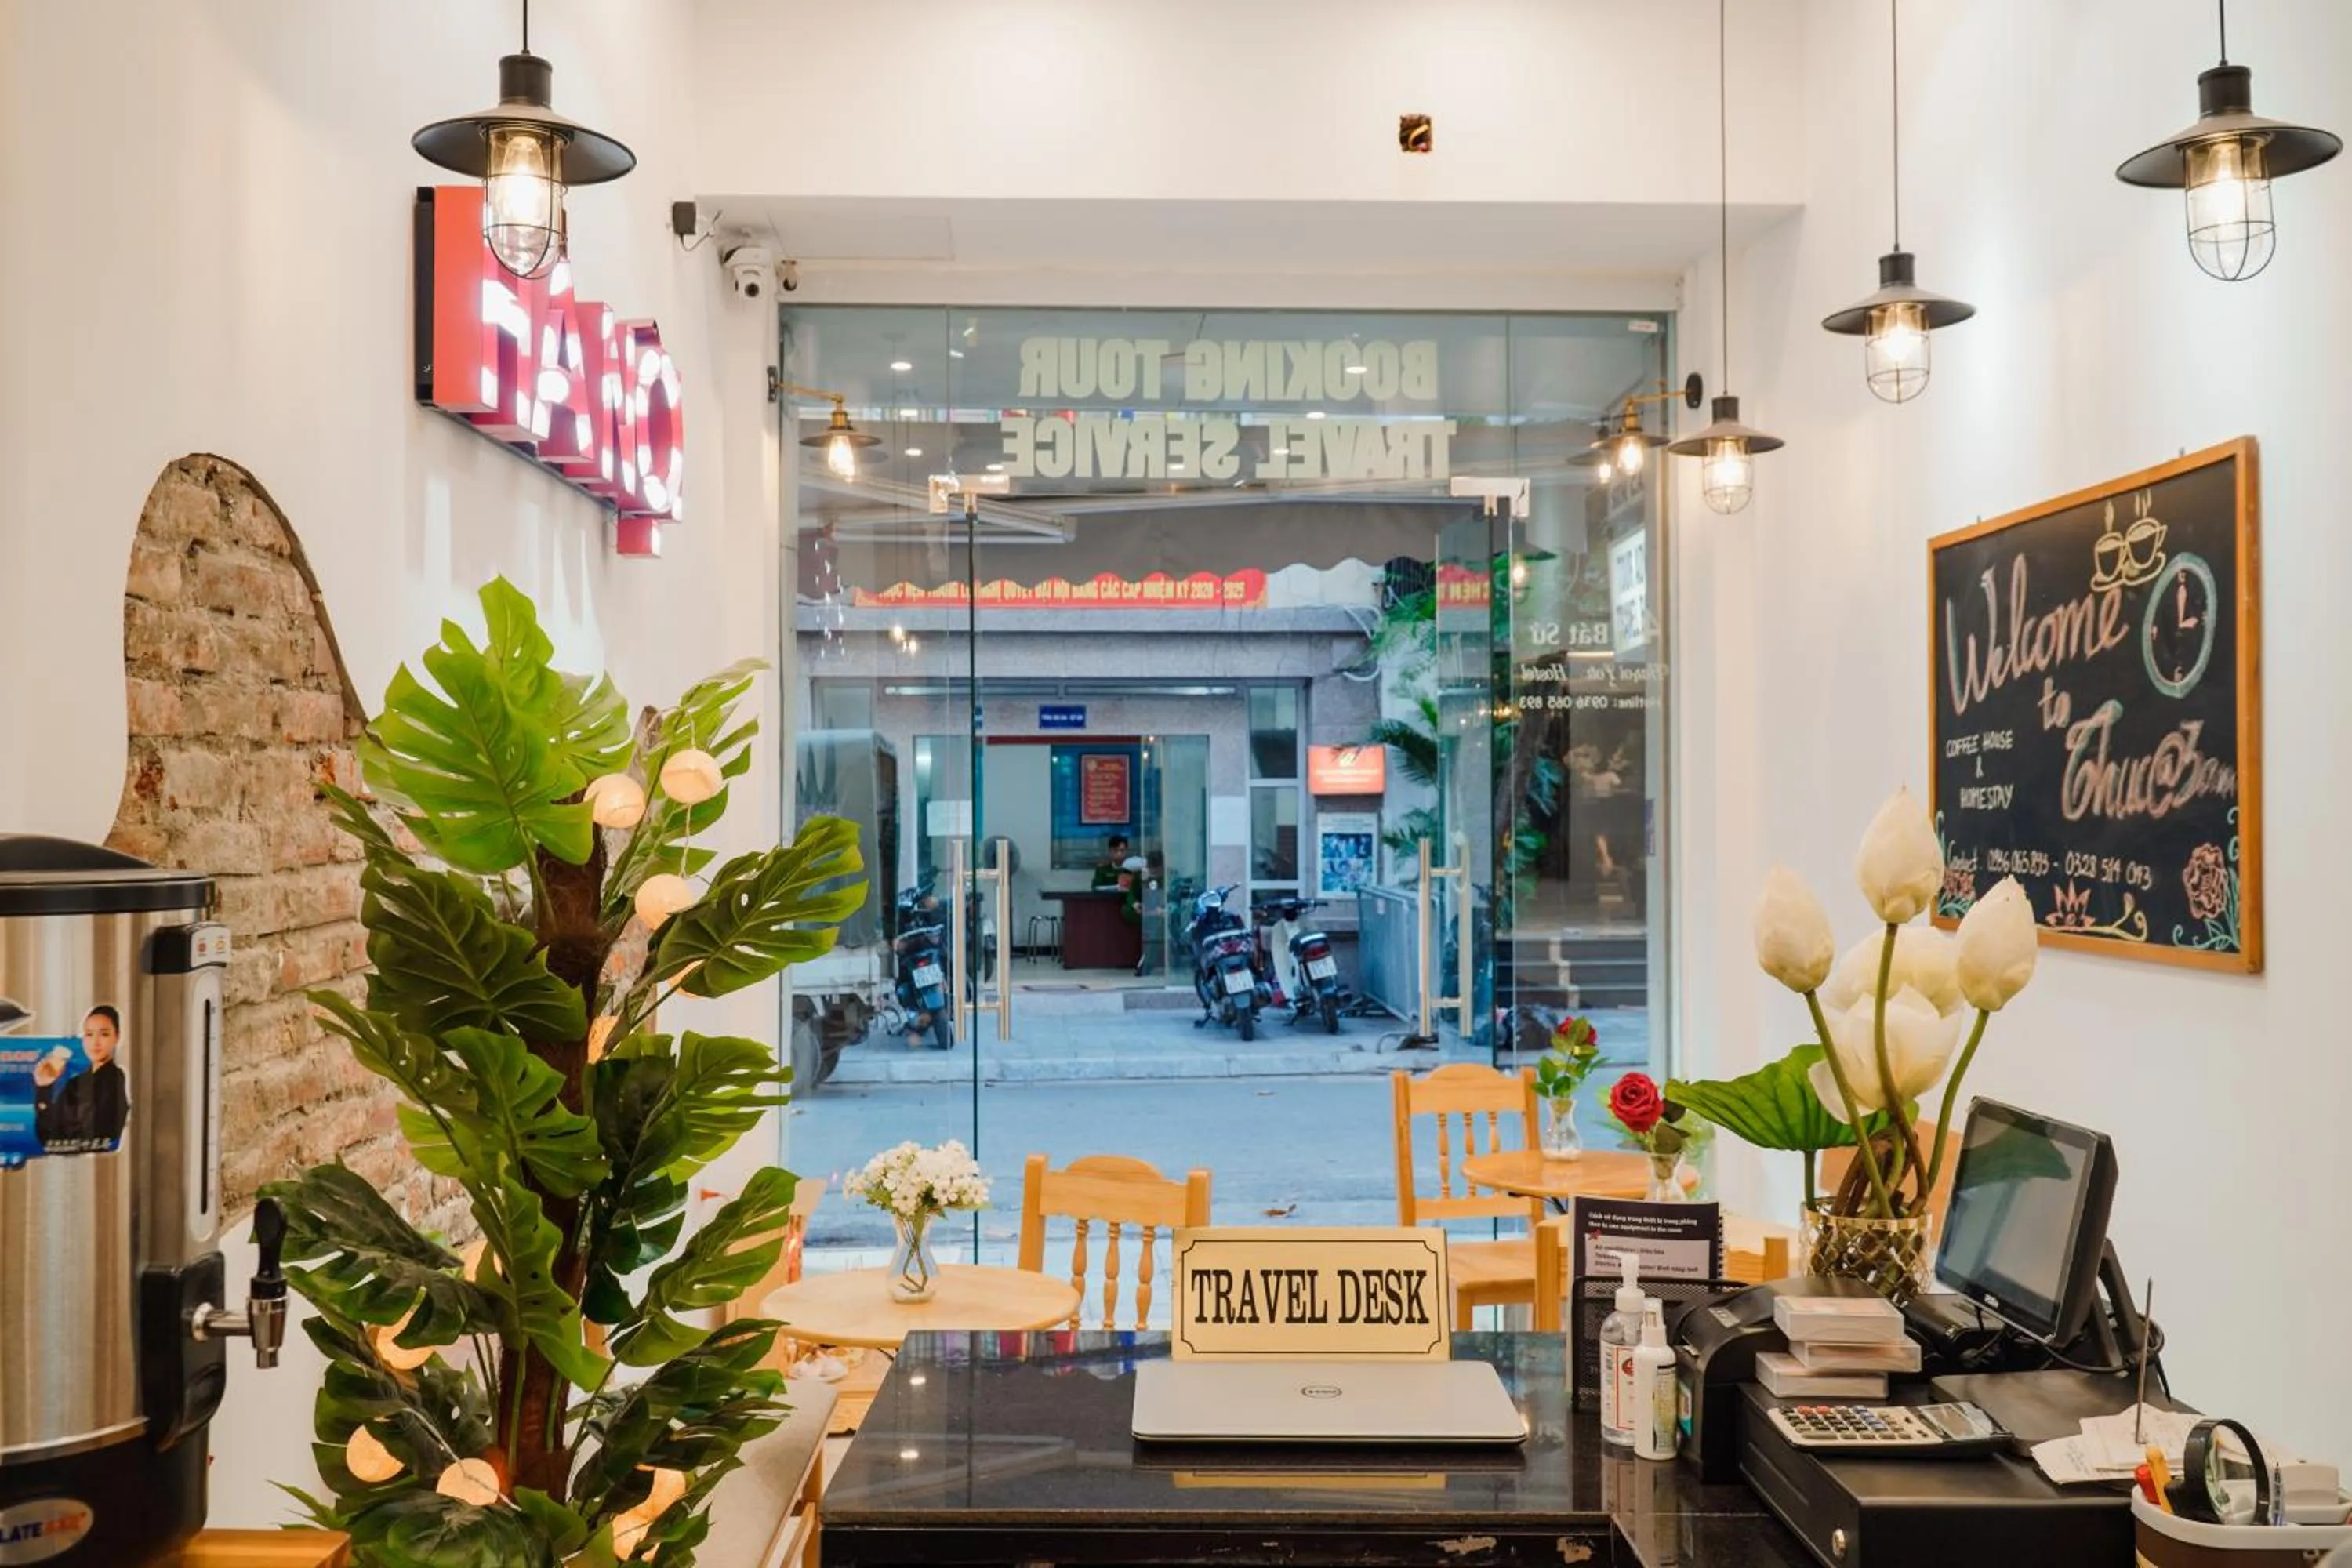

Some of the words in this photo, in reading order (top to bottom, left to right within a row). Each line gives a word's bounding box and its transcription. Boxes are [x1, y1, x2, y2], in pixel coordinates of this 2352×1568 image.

[1945, 551, 2130, 716] Welcome
[2037, 677, 2071, 731] to
[1946, 734, 1980, 758] COFFEE
[1982, 729, 2013, 752] HOUSE
[1960, 783, 2014, 810] HOMESTAY
[1191, 1269, 1328, 1324] TRAVEL
[1337, 1268, 1430, 1326] DESK
